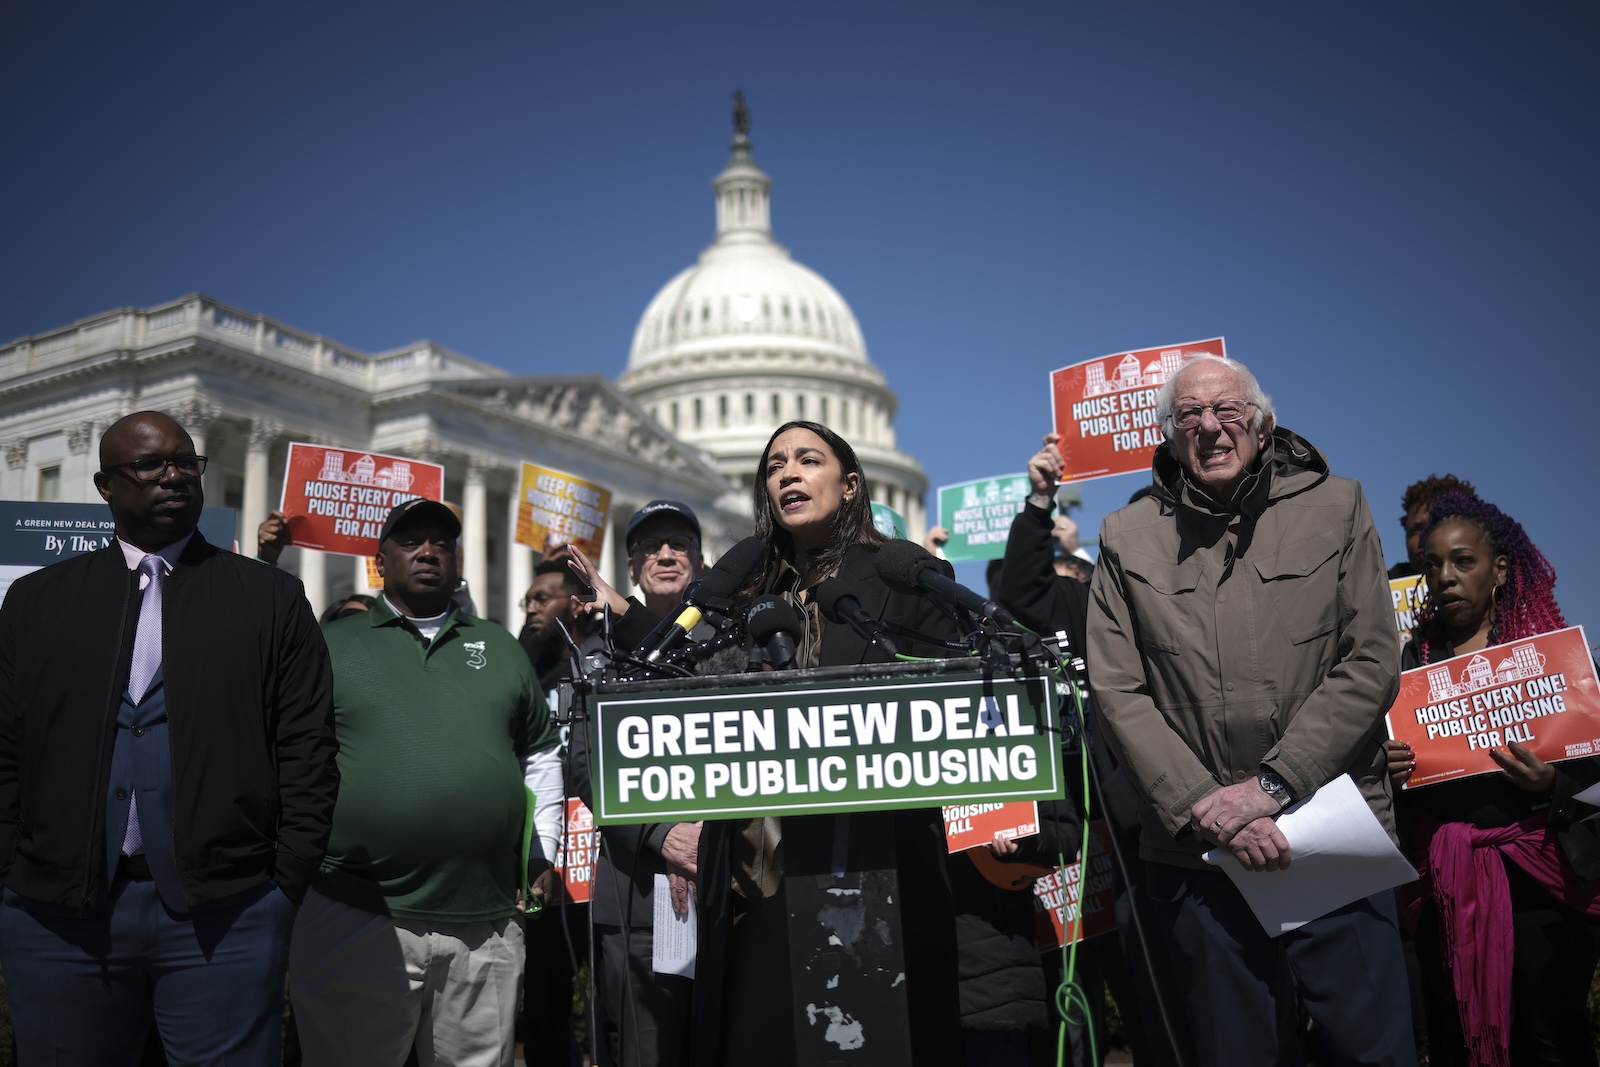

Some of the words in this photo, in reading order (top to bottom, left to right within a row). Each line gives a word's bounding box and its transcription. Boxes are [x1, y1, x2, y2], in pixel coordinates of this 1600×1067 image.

[1072, 395, 1118, 421] HOUSE
[1080, 411, 1130, 438] PUBLIC
[1113, 430, 1141, 452] FOR
[305, 481, 347, 501] HOUSE
[350, 487, 390, 507] EVERY
[308, 499, 355, 519] PUBLIC
[24, 519, 51, 528] GREEN
[54, 520, 73, 528] NEW
[75, 521, 97, 529] DEAL
[334, 518, 360, 537] FOR
[45, 535, 66, 555] By
[70, 536, 97, 552] The
[1415, 698, 1472, 725] HOUSE
[1472, 683, 1523, 712] EVERY
[1526, 673, 1568, 699] ONE!
[617, 708, 776, 759] GREEN
[787, 701, 898, 749] NEW
[910, 694, 1035, 742] DEAL
[1426, 714, 1487, 740] PUBLIC
[1488, 695, 1567, 729] HOUSING
[1468, 731, 1502, 751] FOR
[1504, 723, 1536, 746] ALL
[1566, 747, 1592, 757] RISING
[618, 765, 696, 803] FOR
[704, 755, 847, 798] PUBLIC
[856, 745, 1037, 790] HOUSING
[948, 818, 974, 836] ALL
